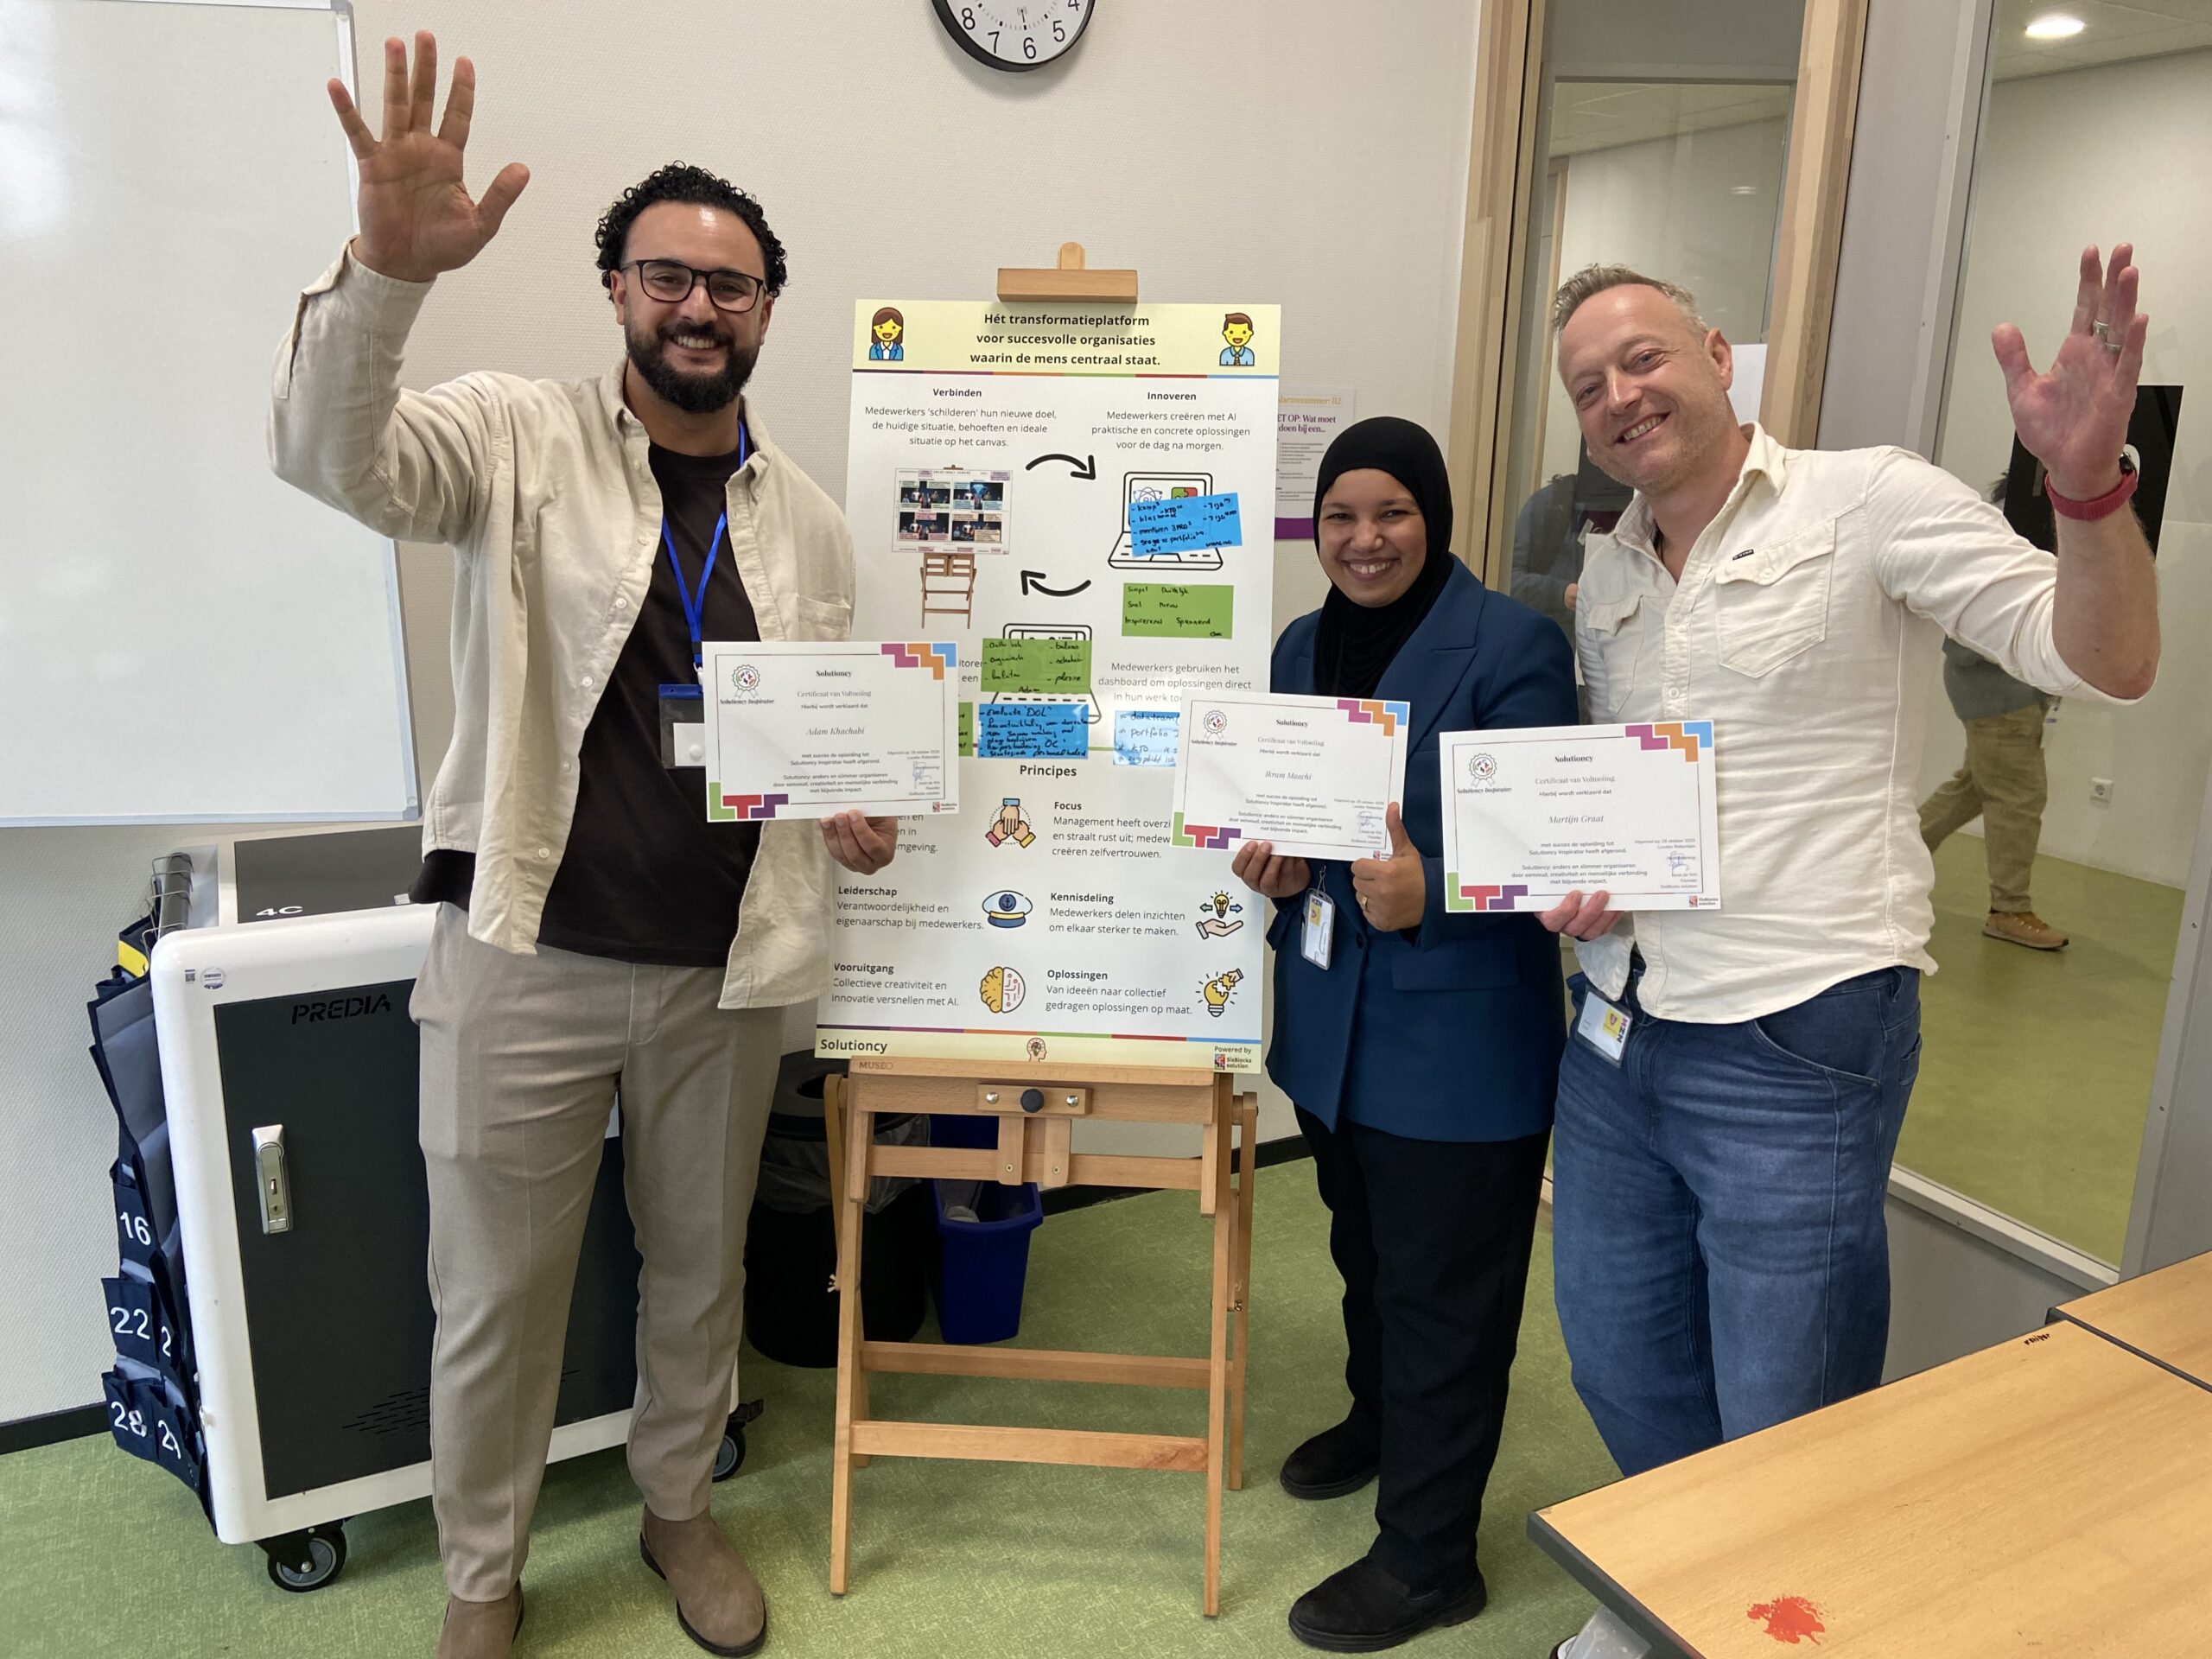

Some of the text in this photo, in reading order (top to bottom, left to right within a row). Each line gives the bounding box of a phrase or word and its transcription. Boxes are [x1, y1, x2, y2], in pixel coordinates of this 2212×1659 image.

[962, 7, 976, 30] 8
[1052, 20, 1065, 42] 5
[988, 31, 1000, 54] 7
[1023, 37, 1037, 59] 6
[984, 315, 1149, 327] Hét transformatieplatform
[977, 334, 1155, 346] voor succesvolle organisaties
[970, 353, 1160, 365] waarin de mens centraal staat.
[933, 389, 982, 397] Verbinden
[865, 407, 925, 416] Medewerkers
[928, 408, 977, 417] 'schilderen'
[1035, 410, 1056, 419] doel,
[1107, 411, 1167, 421] Medewerkers
[887, 422, 918, 432] huidige
[921, 423, 956, 432] situatie,
[1092, 425, 1138, 435] praktische
[1154, 427, 1193, 435] concrete
[1196, 428, 1250, 437] oplossingen
[1299, 424, 1307, 434] bij
[1154, 442, 1169, 451] dag
[1186, 443, 1224, 452] morgen.
[1111, 663, 1239, 675] Medewerkers gebruiken het
[1098, 677, 1147, 686] dashboard
[1167, 679, 1222, 689] oplossingen
[1225, 680, 1251, 689] direct
[1125, 693, 1142, 702] hun
[1145, 693, 1166, 702] werk
[1276, 719, 1308, 728] Solutioncy
[1020, 766, 1077, 779] Principes
[1054, 817, 1114, 829] Management
[1117, 818, 1140, 827] heeft
[1119, 835, 1134, 843] uit;
[1137, 835, 1170, 843] medew
[1090, 848, 1161, 858] zelfvertrouwen.
[838, 887, 897, 897] Leiderschap
[1051, 893, 1114, 905] Kennisdeling
[257, 906, 303, 916] 4C
[837, 901, 935, 913] Verantwoordelijkheid
[1050, 908, 1185, 920] Medewerkers delen inzichten
[836, 918, 983, 930] eigenaarschap bij medewerkers.
[1067, 924, 1095, 932] elkaar
[1145, 927, 1179, 936] maken.
[835, 963, 894, 975] Vooruitgang
[1047, 969, 1108, 981] Oplossingen
[885, 981, 932, 989] creativiteit
[1067, 986, 1097, 995] ideeën
[1125, 988, 1166, 997] collectief
[877, 996, 924, 1005] versnellen
[947, 997, 959, 1006] AI.
[291, 994, 391, 1025] PREDIA
[1046, 1002, 1090, 1012] gedragen
[1092, 1002, 1148, 1014] oplossingen
[1151, 1006, 1163, 1015] op
[820, 1039, 887, 1054] Solutioncy
[120, 1211, 150, 1245] 16
[111, 1306, 149, 1339] 22
[162, 1326, 171, 1357] 2
[111, 1402, 147, 1437] 28
